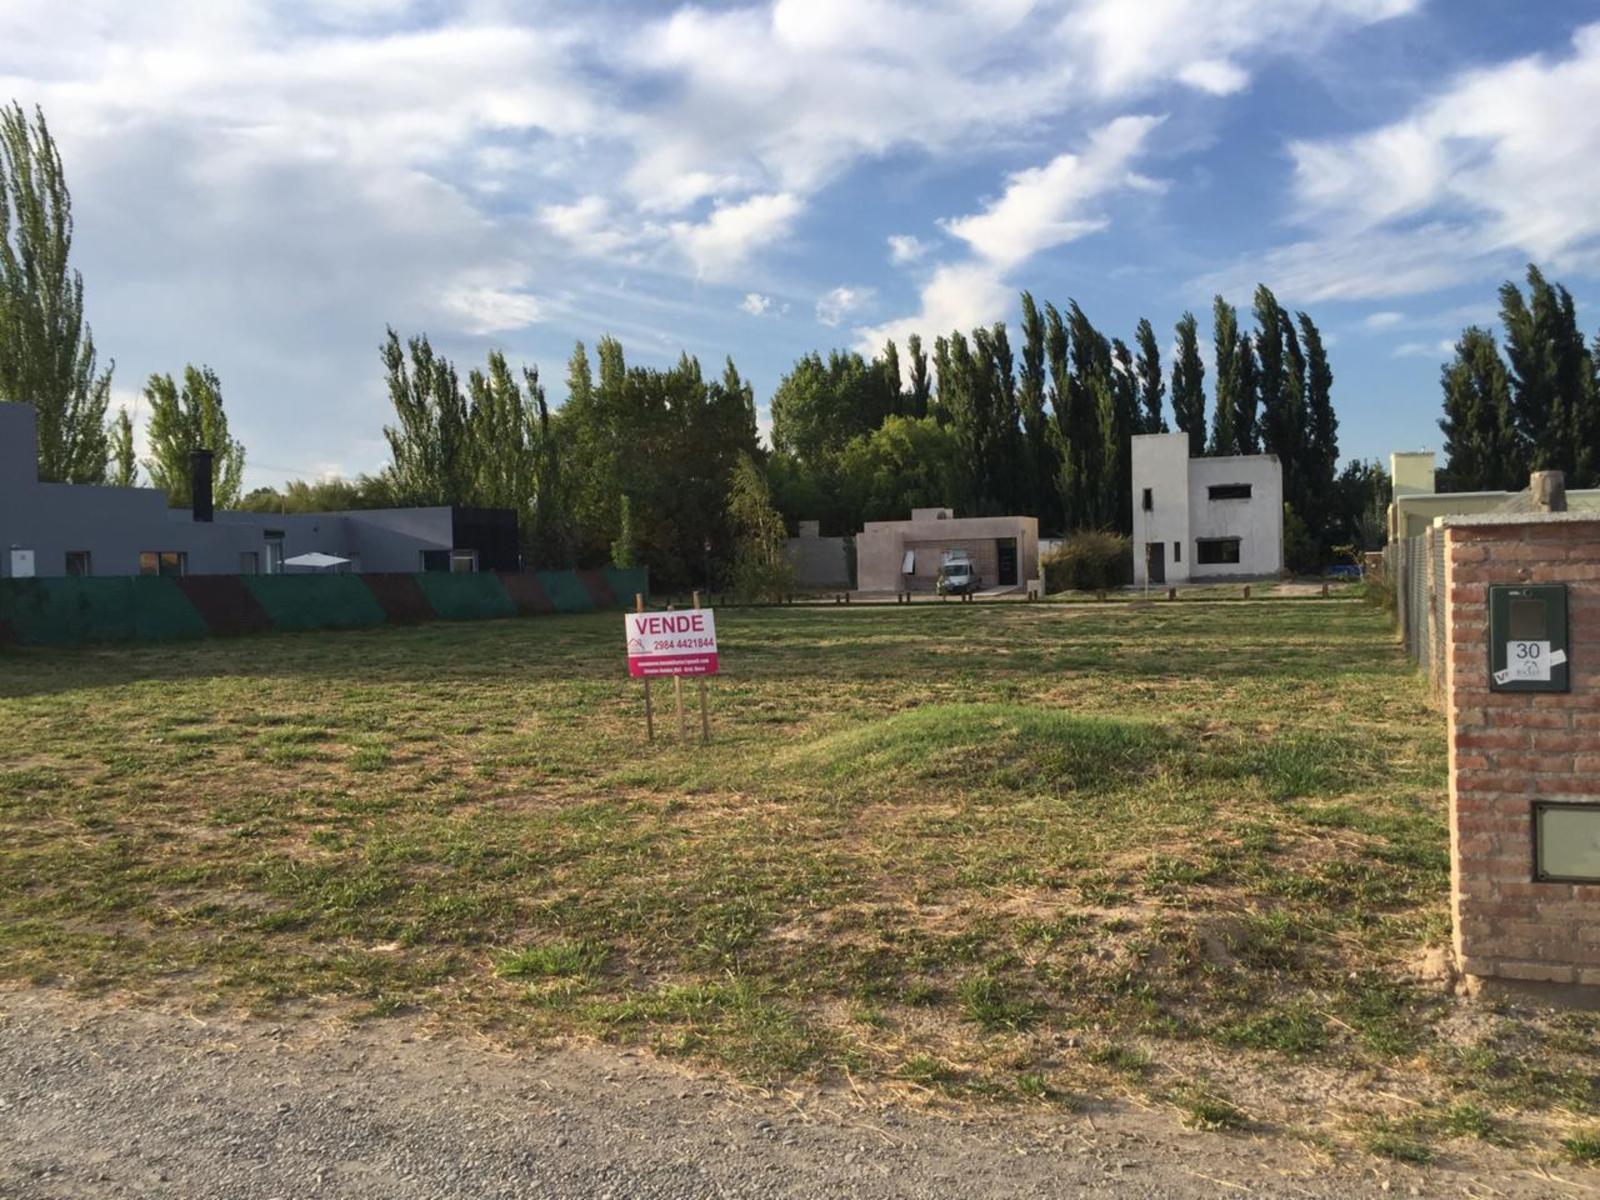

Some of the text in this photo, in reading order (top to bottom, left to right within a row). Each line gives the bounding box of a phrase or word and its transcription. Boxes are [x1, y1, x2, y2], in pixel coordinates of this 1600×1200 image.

[635, 615, 704, 635] VENDE
[654, 638, 714, 650] 2984 4421844
[1516, 643, 1540, 659] 30
